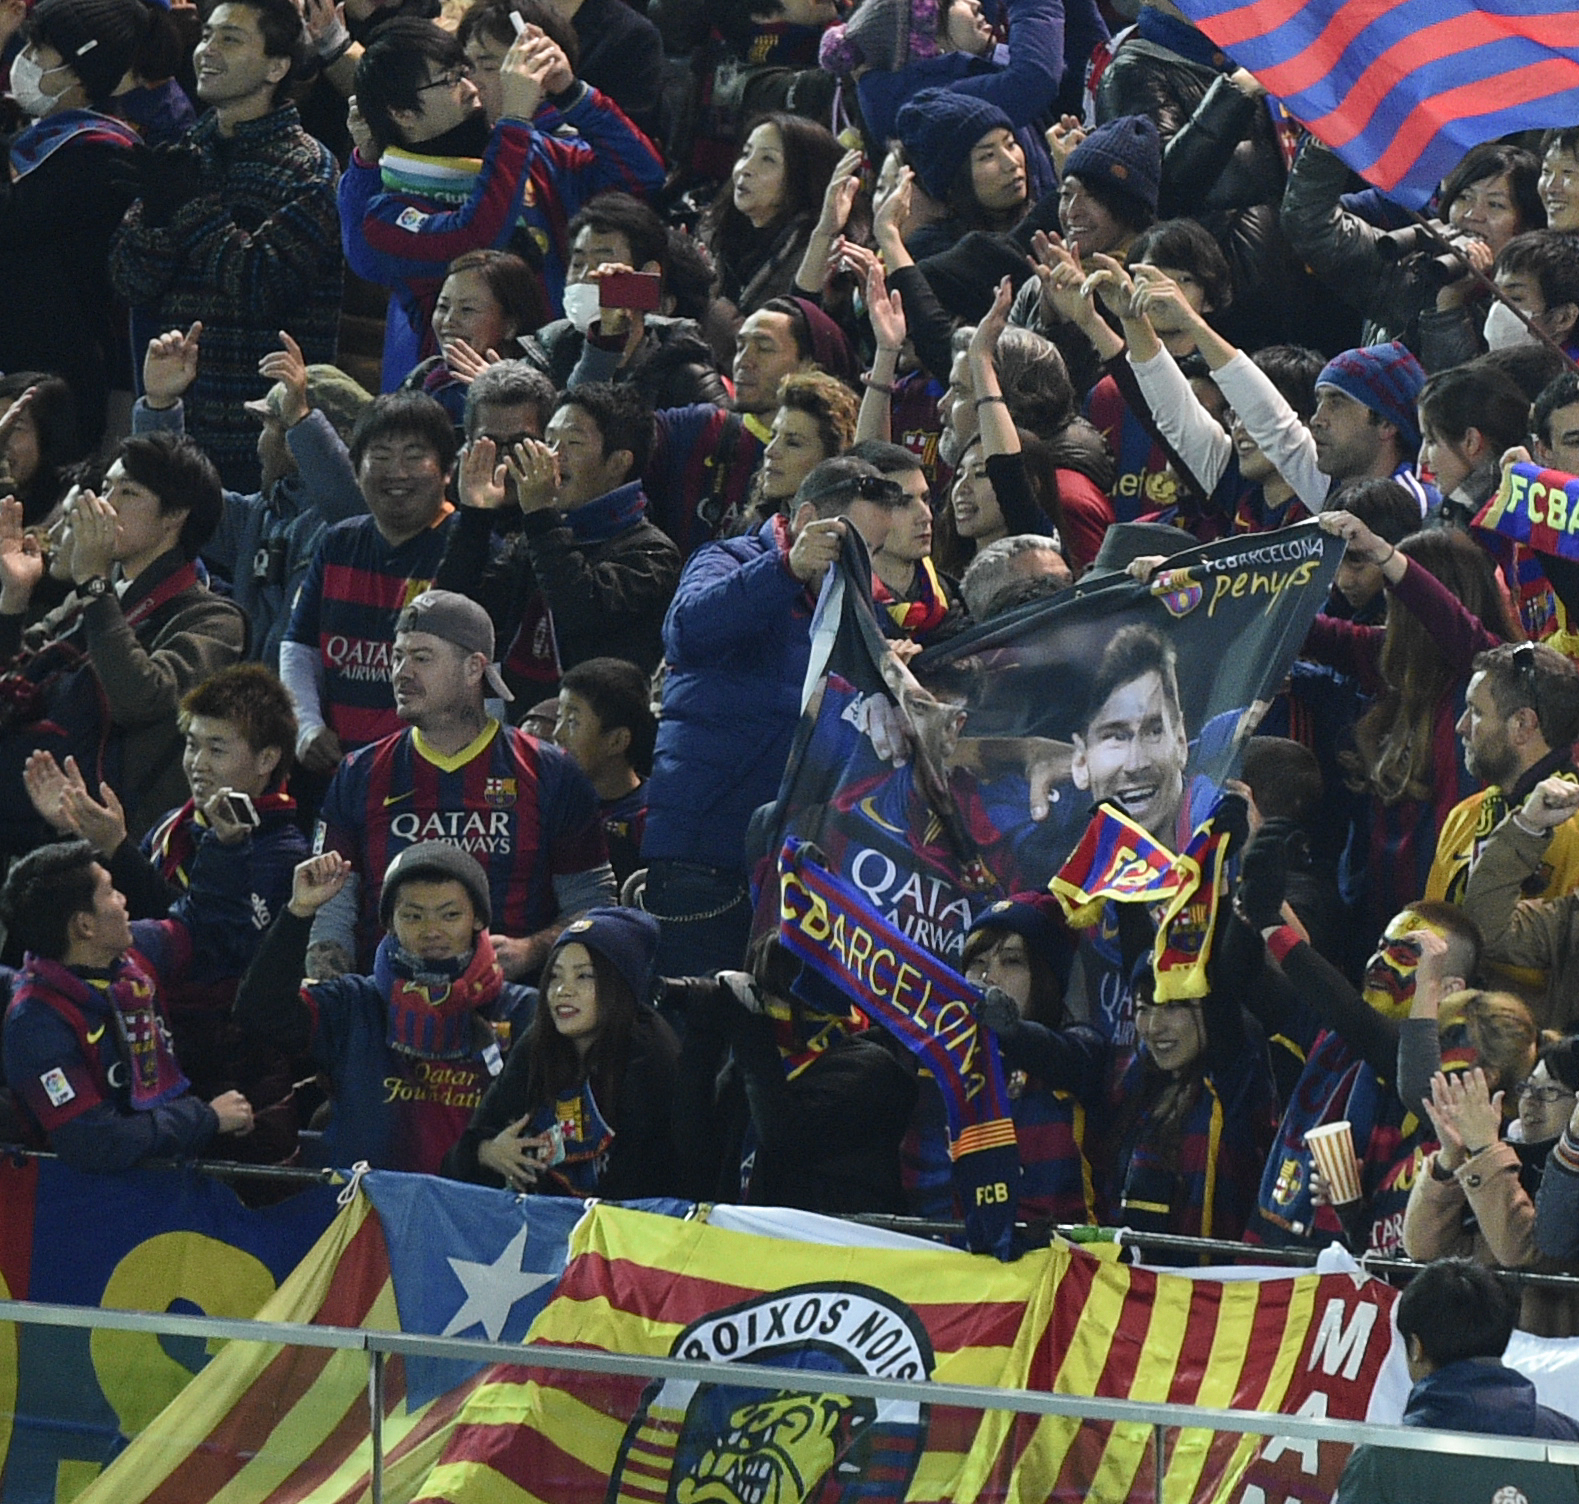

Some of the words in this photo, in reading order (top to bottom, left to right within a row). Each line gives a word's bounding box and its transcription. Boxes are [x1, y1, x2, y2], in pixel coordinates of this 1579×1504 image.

[327, 635, 391, 666] QATA
[339, 664, 393, 683] AIRWAY
[391, 811, 510, 843] QATAR
[851, 848, 973, 931] QATA
[884, 908, 967, 956] AIRWA
[778, 871, 985, 1104] CBARCELONA
[382, 1076, 483, 1109] Foundati
[975, 1181, 1009, 1207] FCB
[682, 1297, 850, 1362] BOIXOS
[847, 1308, 917, 1383] NOIS
